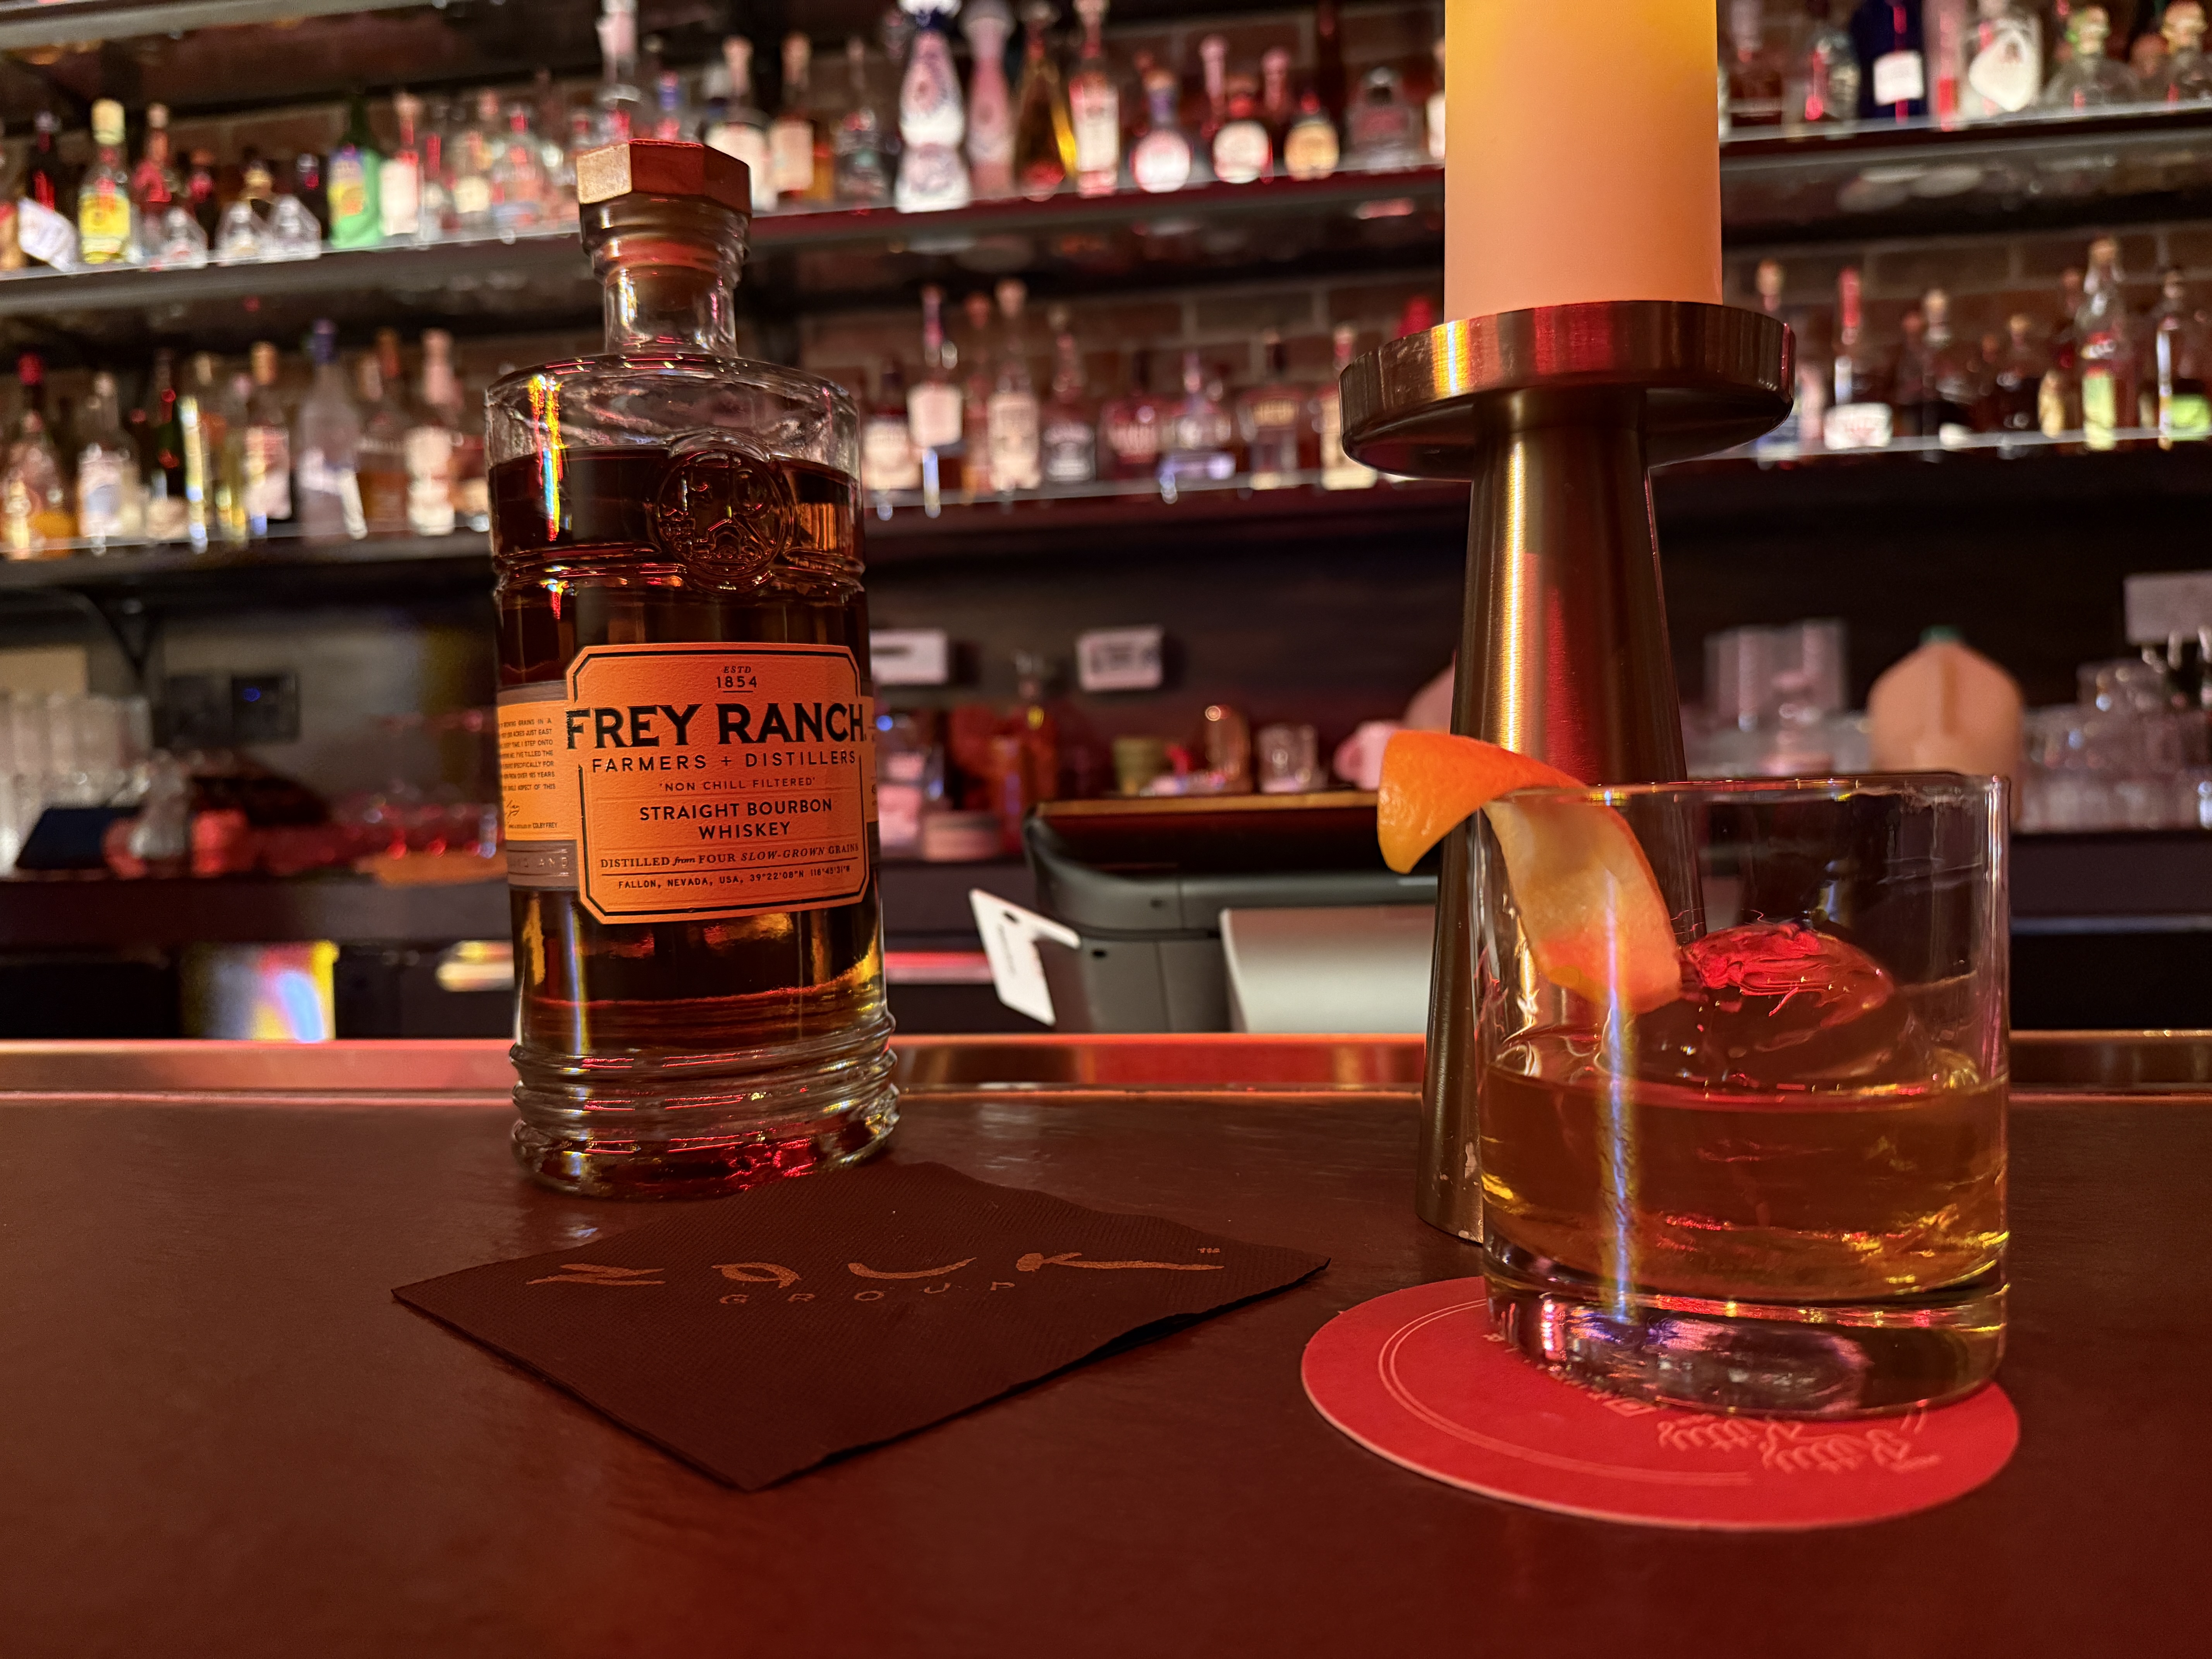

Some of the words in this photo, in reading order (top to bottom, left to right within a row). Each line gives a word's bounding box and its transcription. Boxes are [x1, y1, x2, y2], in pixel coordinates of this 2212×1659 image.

[716, 676, 757, 688] 1854
[564, 704, 703, 749] FREY
[715, 703, 865, 744] RANCH
[592, 755, 706, 773] FARMERS
[745, 750, 855, 767] DISTILLERS
[703, 780, 746, 790] CHILL
[640, 803, 740, 821] STRAIGHT
[747, 798, 832, 816] BOURBON
[698, 821, 791, 840] WHISKEY
[601, 857, 670, 867] DISTILLED
[672, 856, 696, 866] from
[699, 853, 736, 864] FOUR
[741, 847, 825, 861] SLOW-GROWN
[618, 879, 661, 889] FALLON,
[667, 878, 713, 887] NEVADA,
[720, 1281, 1015, 1304] GROUP
